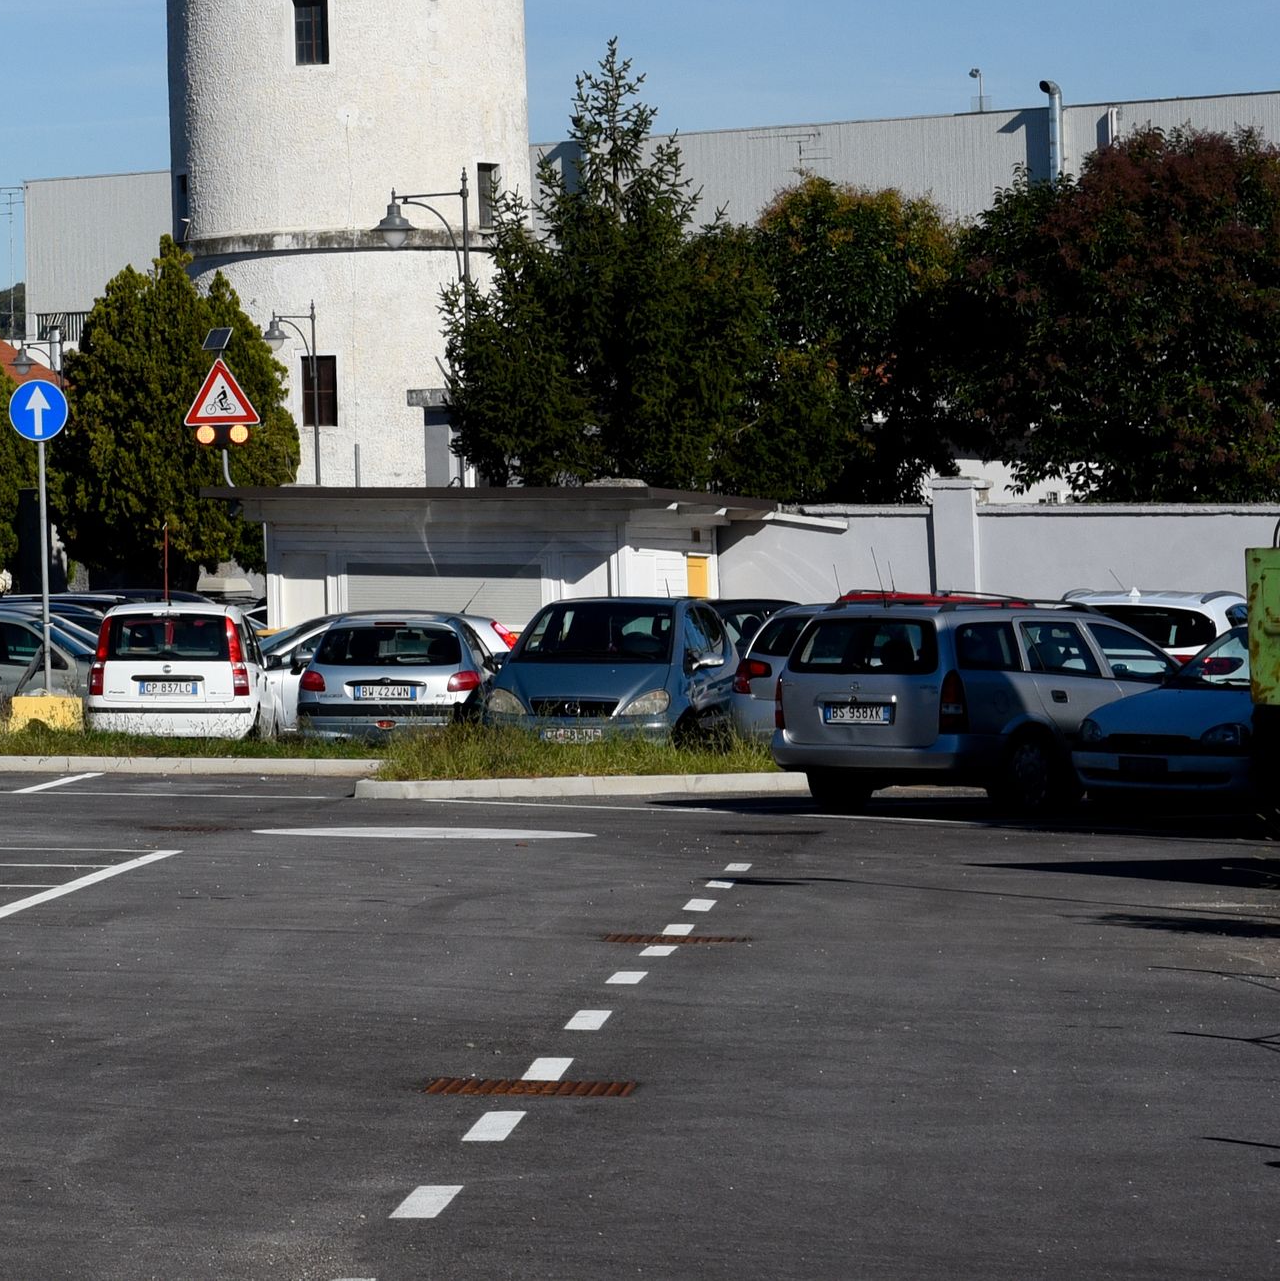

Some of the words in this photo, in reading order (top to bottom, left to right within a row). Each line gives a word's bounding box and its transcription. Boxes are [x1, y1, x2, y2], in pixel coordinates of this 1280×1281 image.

[145, 683, 158, 693] CP
[161, 683, 191, 693] 837LC
[378, 689, 410, 697] 424WN
[832, 706, 845, 719] BS
